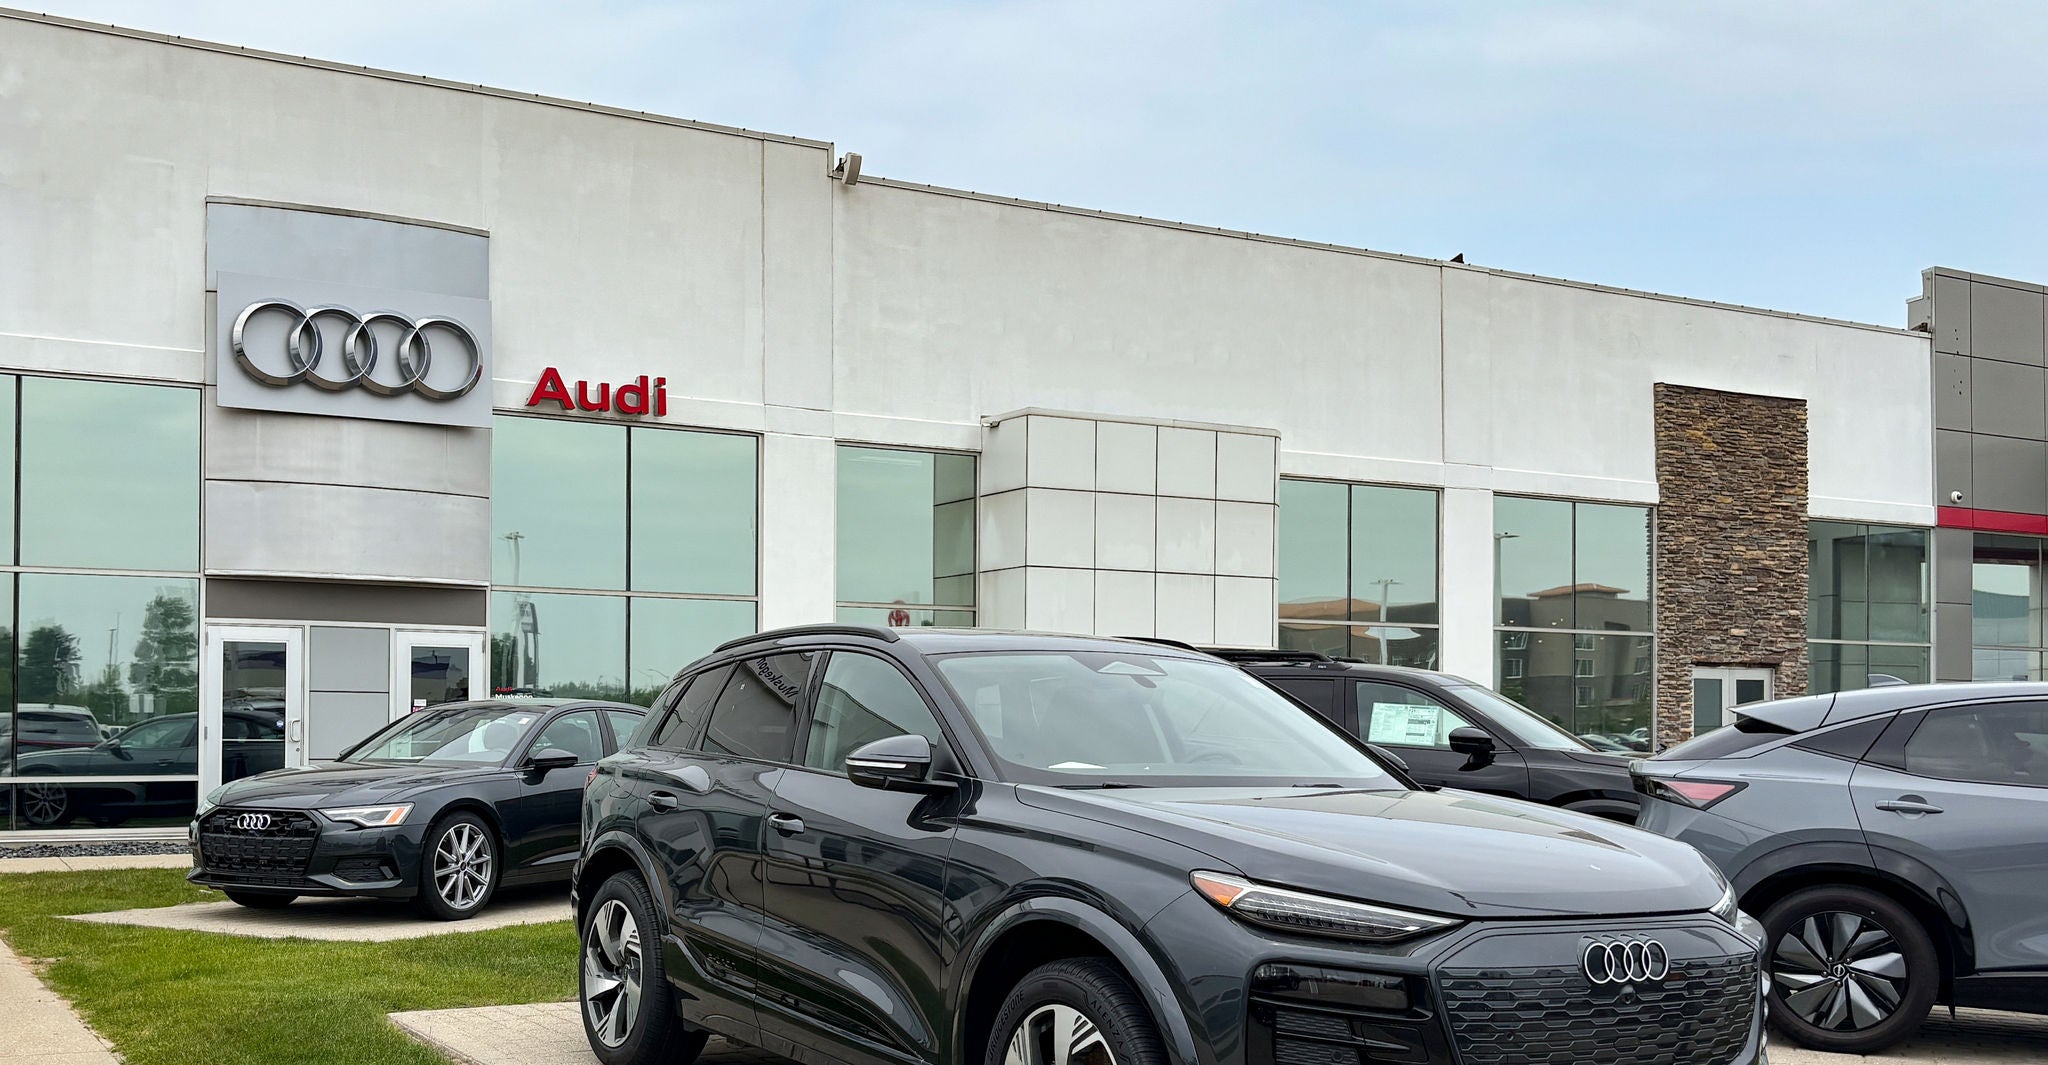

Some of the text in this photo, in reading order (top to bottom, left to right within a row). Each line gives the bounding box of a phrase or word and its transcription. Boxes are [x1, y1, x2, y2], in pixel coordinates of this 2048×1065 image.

[525, 367, 667, 416] Audi
[988, 989, 1024, 1060] BRIDGESTONE
[1090, 1000, 1123, 1049] ALENZA
